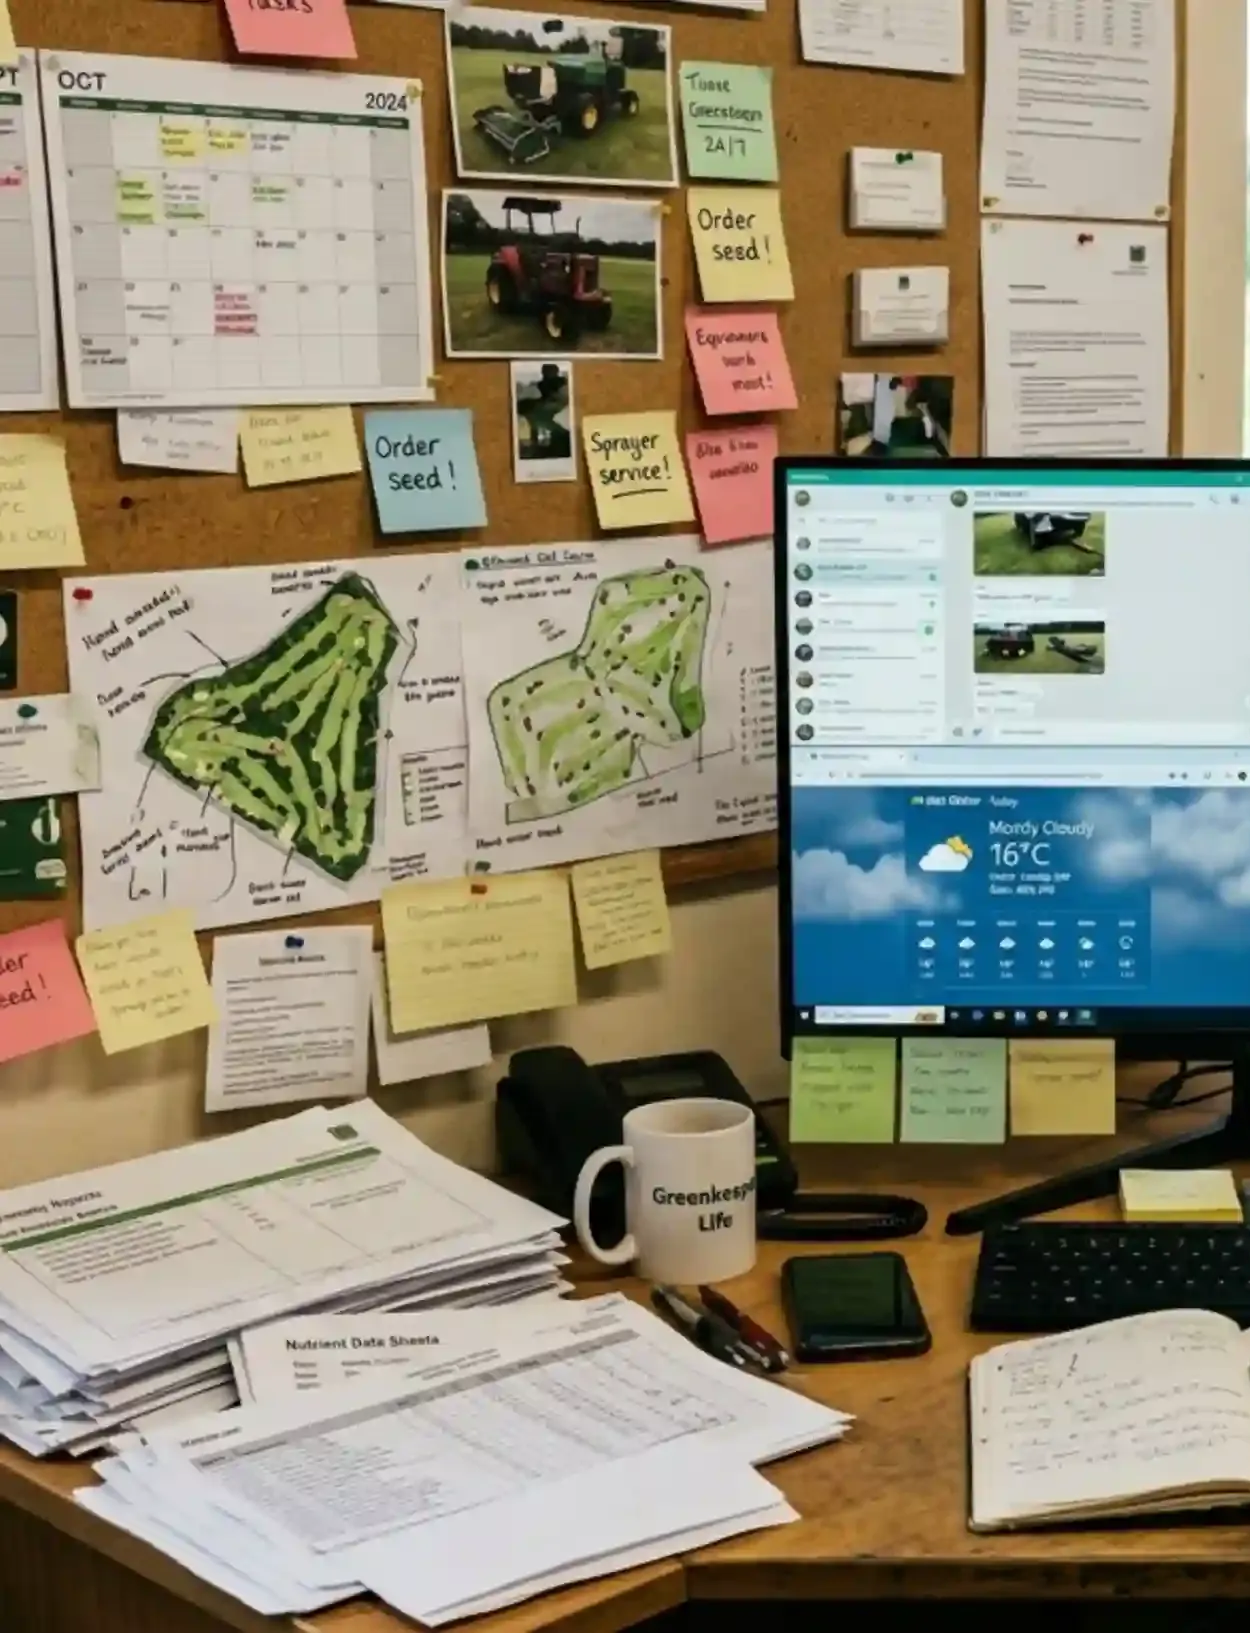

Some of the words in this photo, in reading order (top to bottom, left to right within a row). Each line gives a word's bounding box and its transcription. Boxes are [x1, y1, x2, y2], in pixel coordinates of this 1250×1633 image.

[58, 71, 107, 91] OCT
[365, 92, 407, 111] 2024
[698, 208, 756, 230] Order
[375, 434, 440, 458] Order
[590, 431, 660, 462] Sprayer
[600, 455, 671, 486] service!
[1042, 820, 1095, 839] Cloudy
[286, 1338, 347, 1351] Nutrient
[352, 1336, 384, 1349] Data
